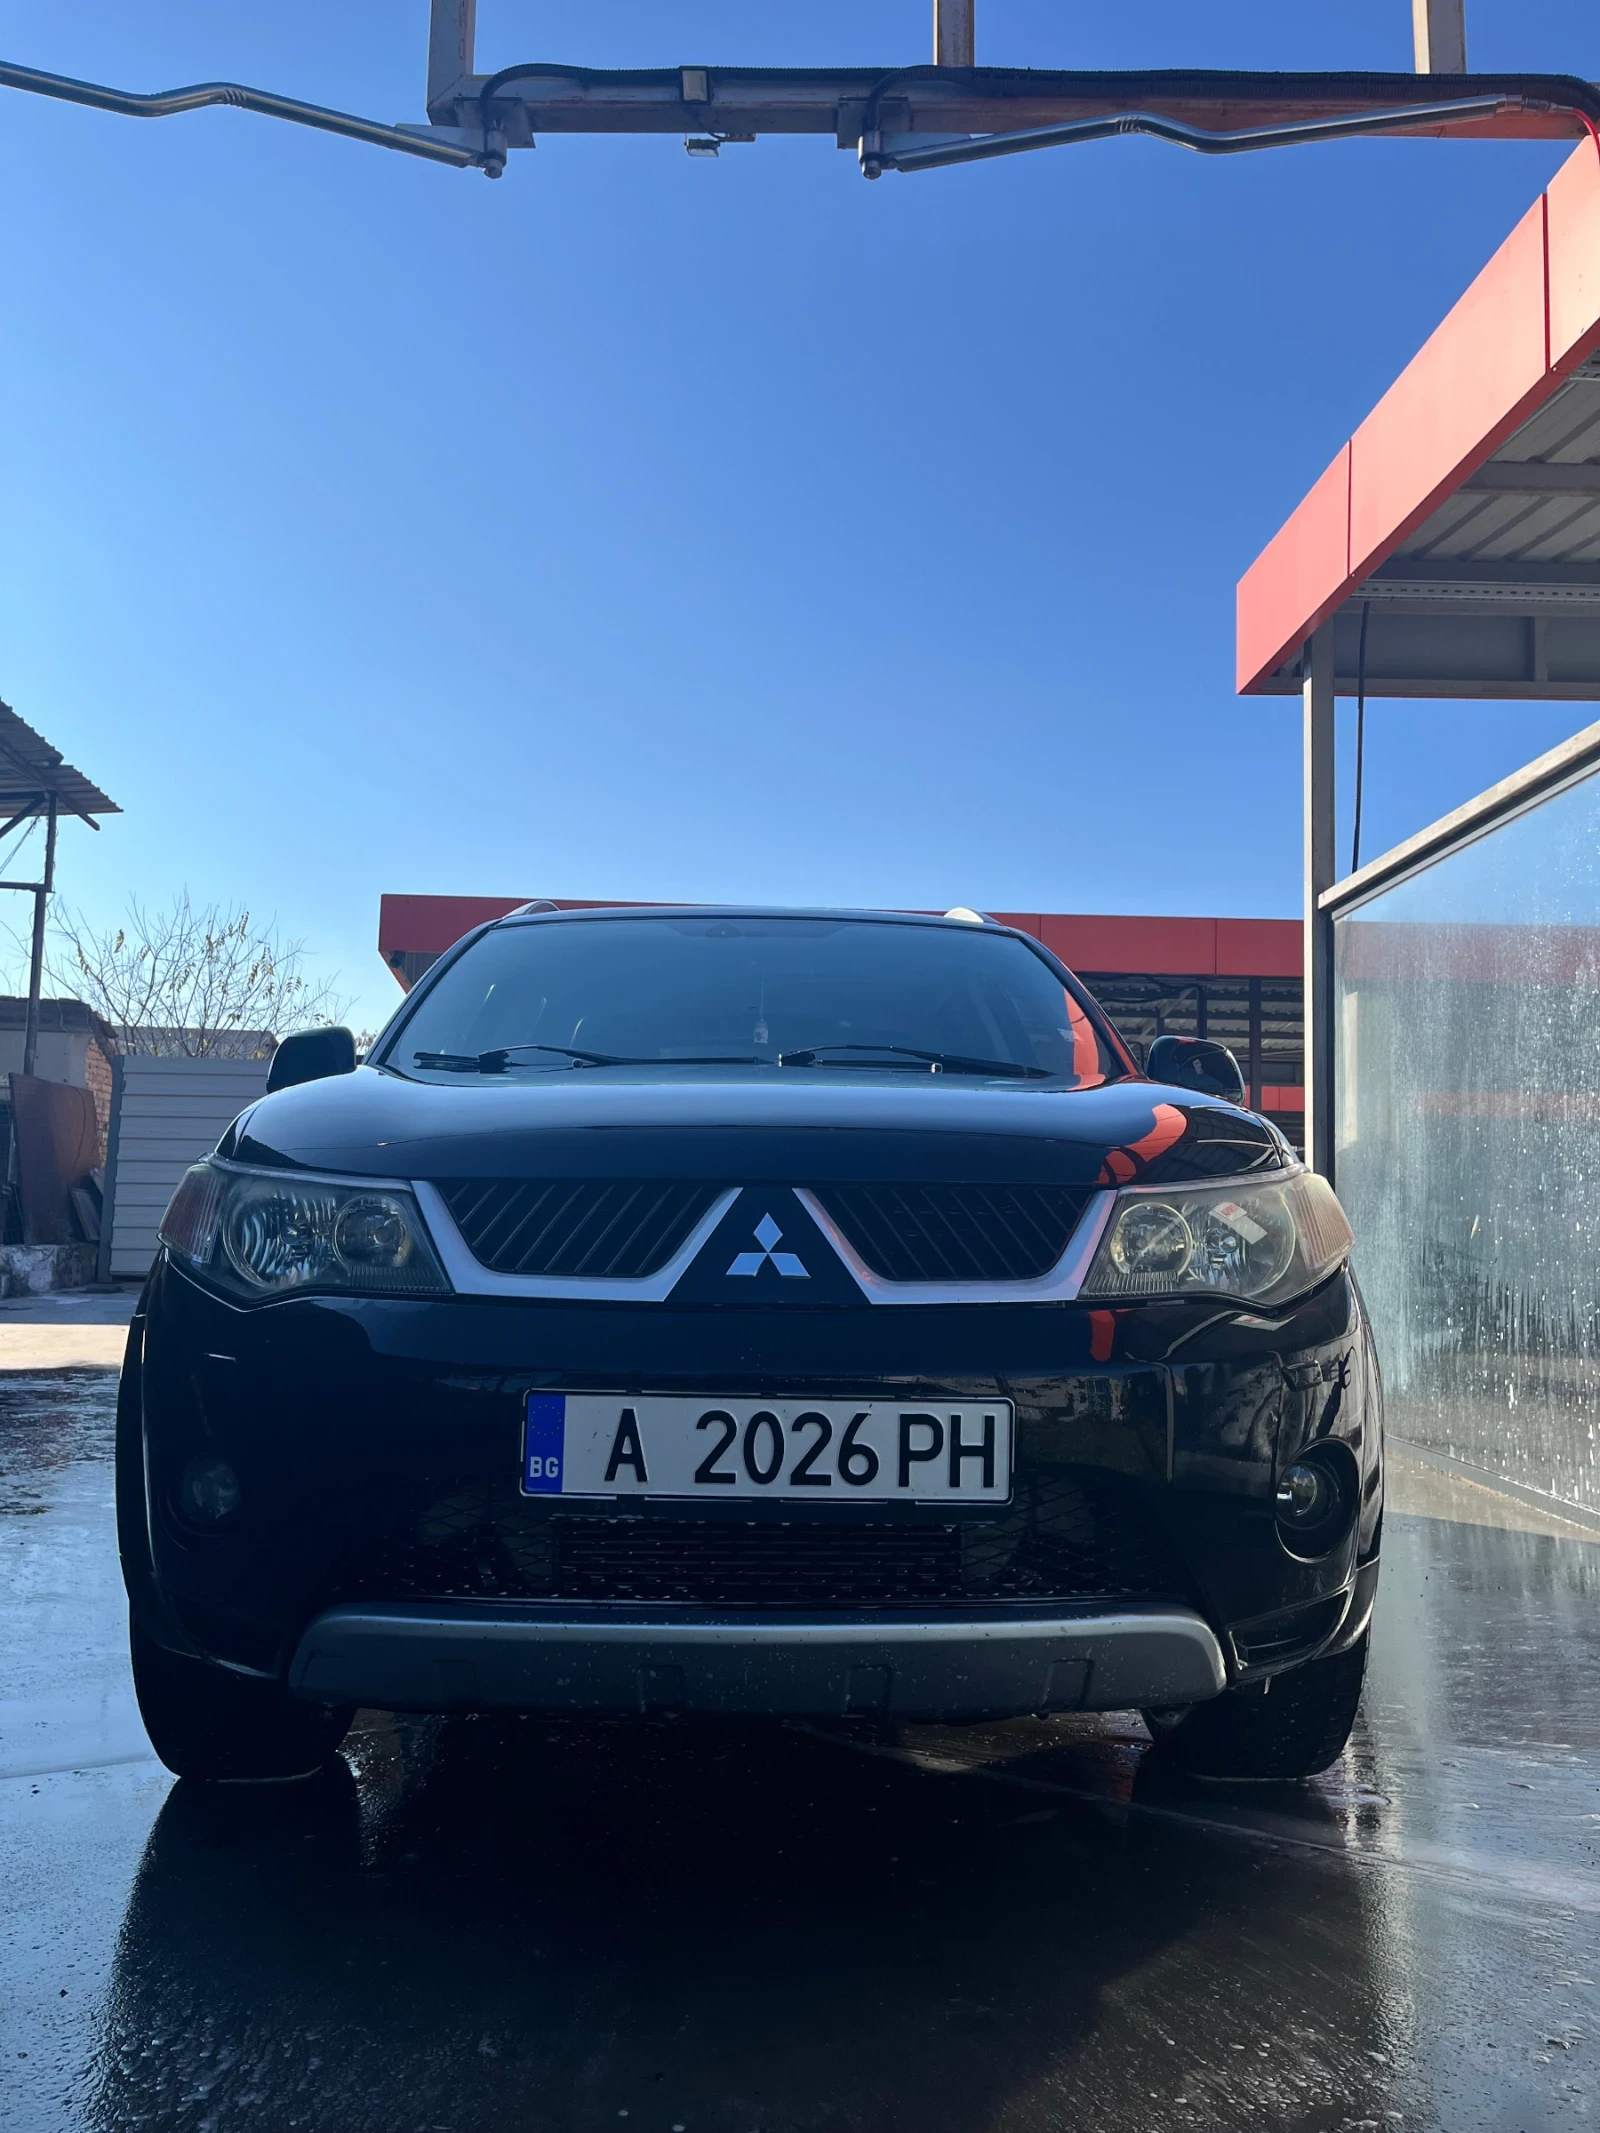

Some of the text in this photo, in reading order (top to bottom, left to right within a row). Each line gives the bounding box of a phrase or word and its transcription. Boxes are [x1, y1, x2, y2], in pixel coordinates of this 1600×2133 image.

[529, 1456, 559, 1478] BG
[604, 1408, 995, 1489] A 2026 PH
